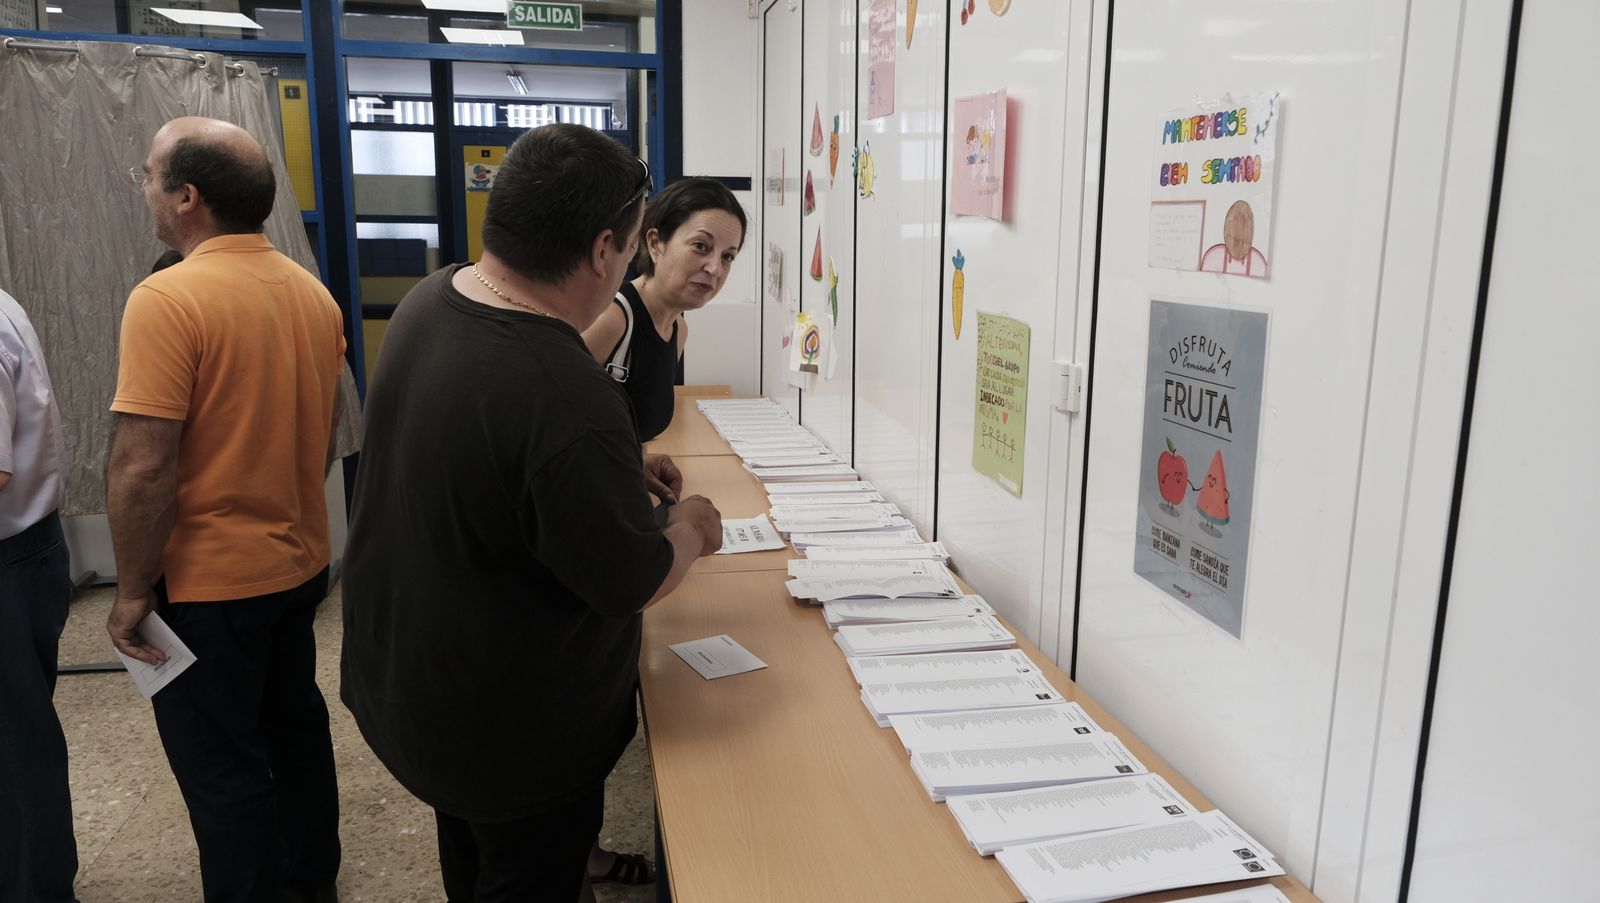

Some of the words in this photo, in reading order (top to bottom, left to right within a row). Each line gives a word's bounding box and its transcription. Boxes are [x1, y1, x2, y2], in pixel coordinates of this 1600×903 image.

[515, 5, 574, 24] SALIDA
[1169, 335, 1232, 377] DISFRUTA
[1182, 355, 1217, 375] Comiendo
[1163, 379, 1233, 433] FRUTA
[1161, 542, 1166, 552] ES
[1166, 545, 1177, 560] SANA
[1190, 546, 1202, 560] COME
[1202, 553, 1219, 570] SANDÍA
[1220, 562, 1229, 576] QUE
[1189, 558, 1195, 570] TE
[1195, 562, 1212, 579] ALEGRA
[1212, 571, 1218, 583] EL
[1218, 573, 1228, 589] DÍA
